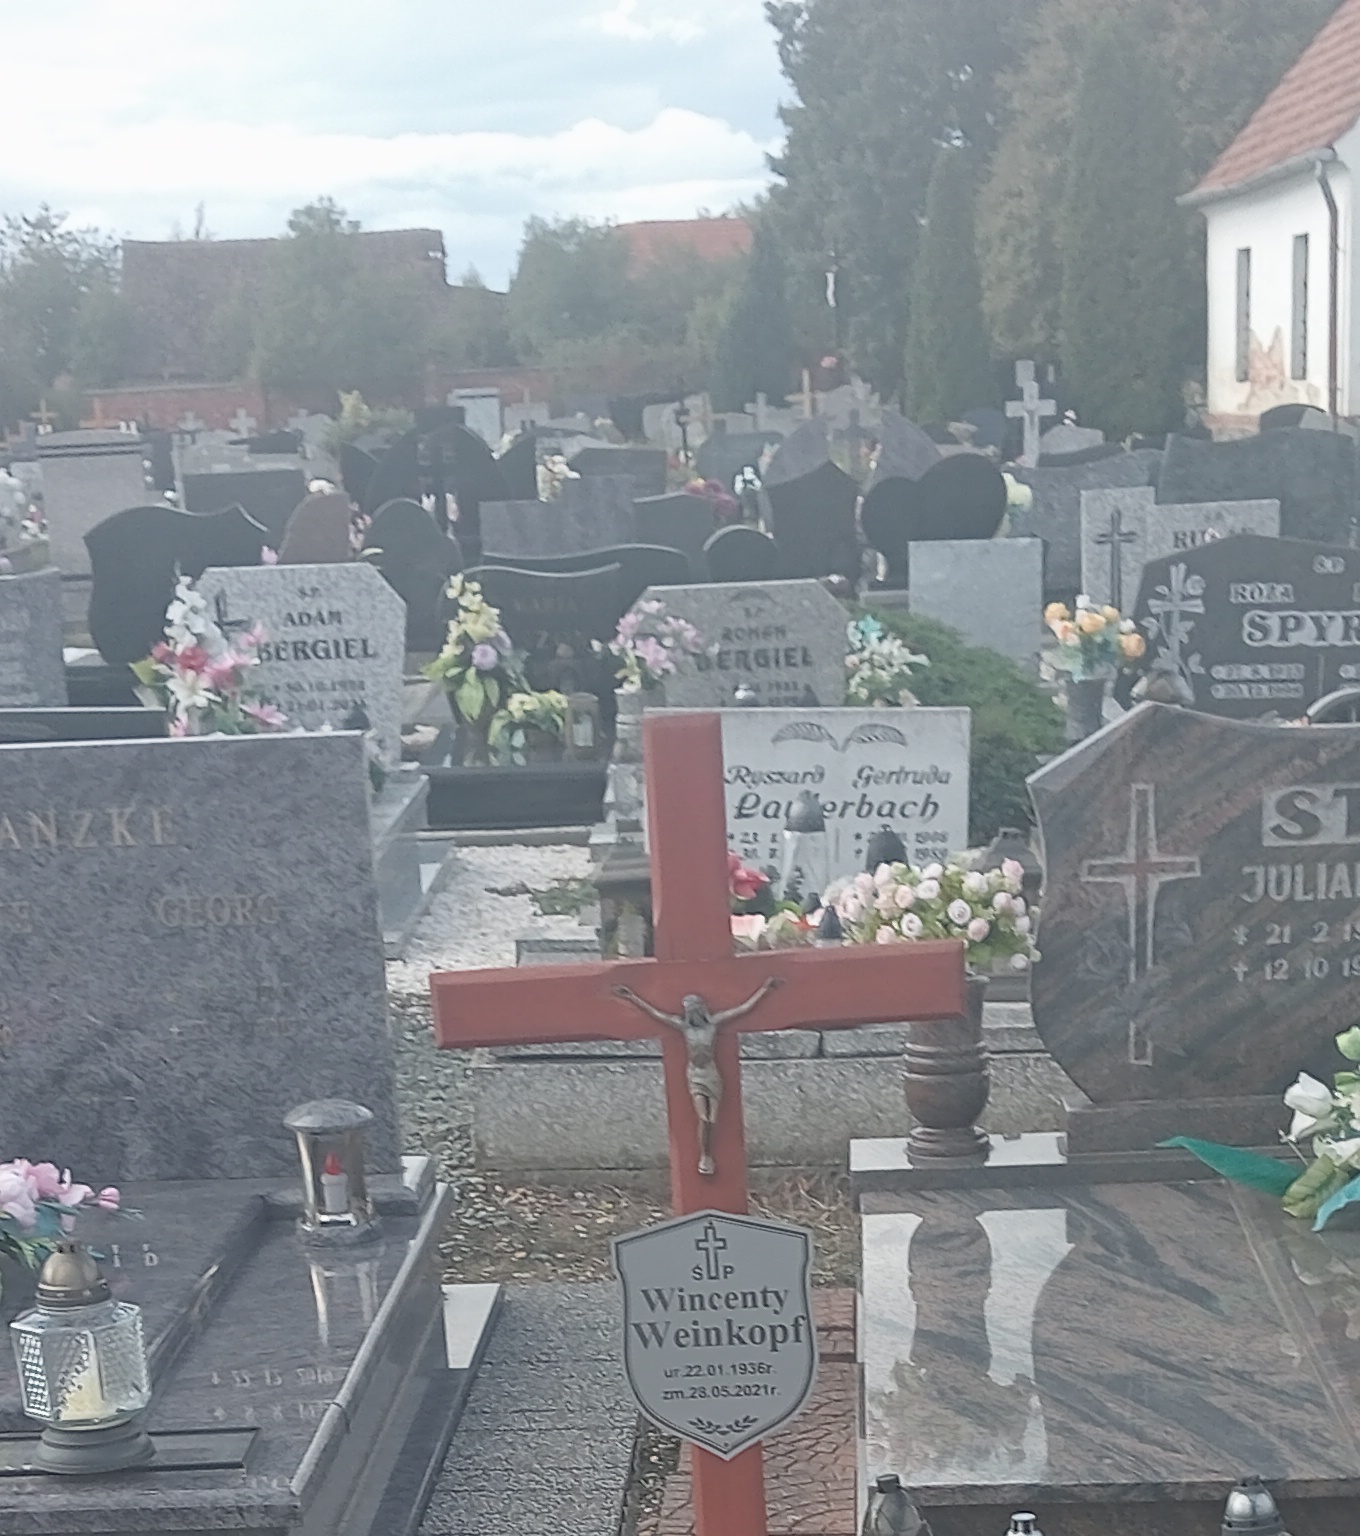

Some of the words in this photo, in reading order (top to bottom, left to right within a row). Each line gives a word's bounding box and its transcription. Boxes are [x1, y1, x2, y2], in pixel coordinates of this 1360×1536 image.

[283, 611, 344, 627] ADAM
[256, 638, 378, 663] BERGIEL
[724, 764, 827, 790] Ryszard
[851, 764, 952, 790] Gertruda
[733, 792, 940, 824] Laerbach
[1265, 923, 1292, 945] 21
[1311, 920, 1331, 944] 2
[1264, 957, 1291, 981] 12
[1304, 956, 1330, 980] 10
[723, 1265, 736, 1280] P
[641, 1285, 790, 1316] Wincenty
[631, 1315, 808, 1353] Weinkopf
